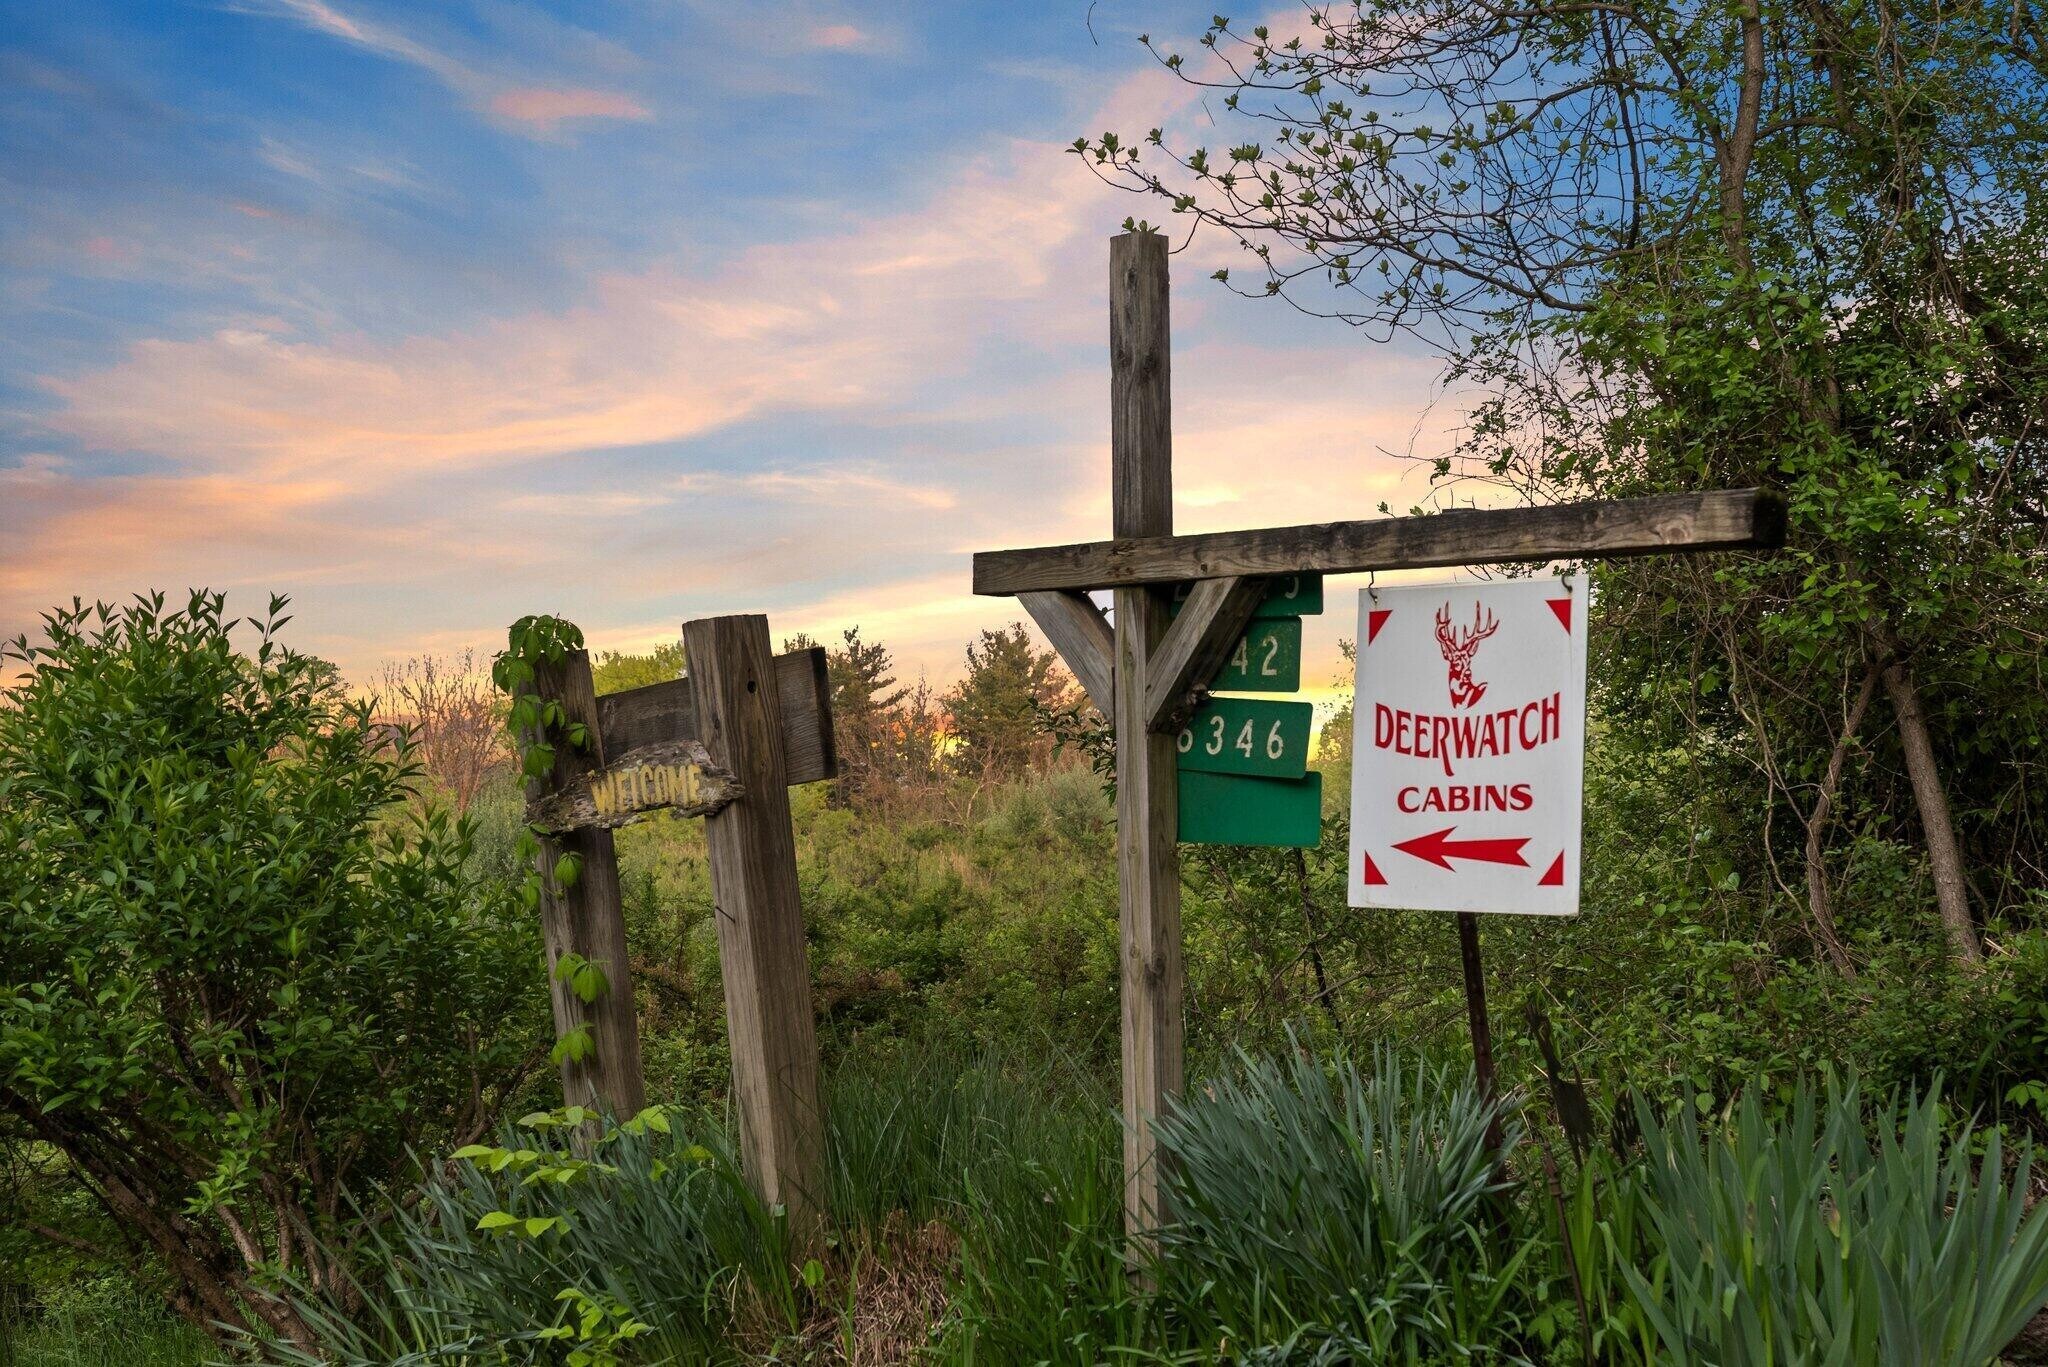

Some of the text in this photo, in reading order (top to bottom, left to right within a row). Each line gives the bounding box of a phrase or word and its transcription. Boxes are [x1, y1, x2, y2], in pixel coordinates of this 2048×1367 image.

[1375, 692, 1560, 777] DEERWATCH
[591, 763, 702, 815] WELCOME
[1397, 784, 1533, 813] CABINS
